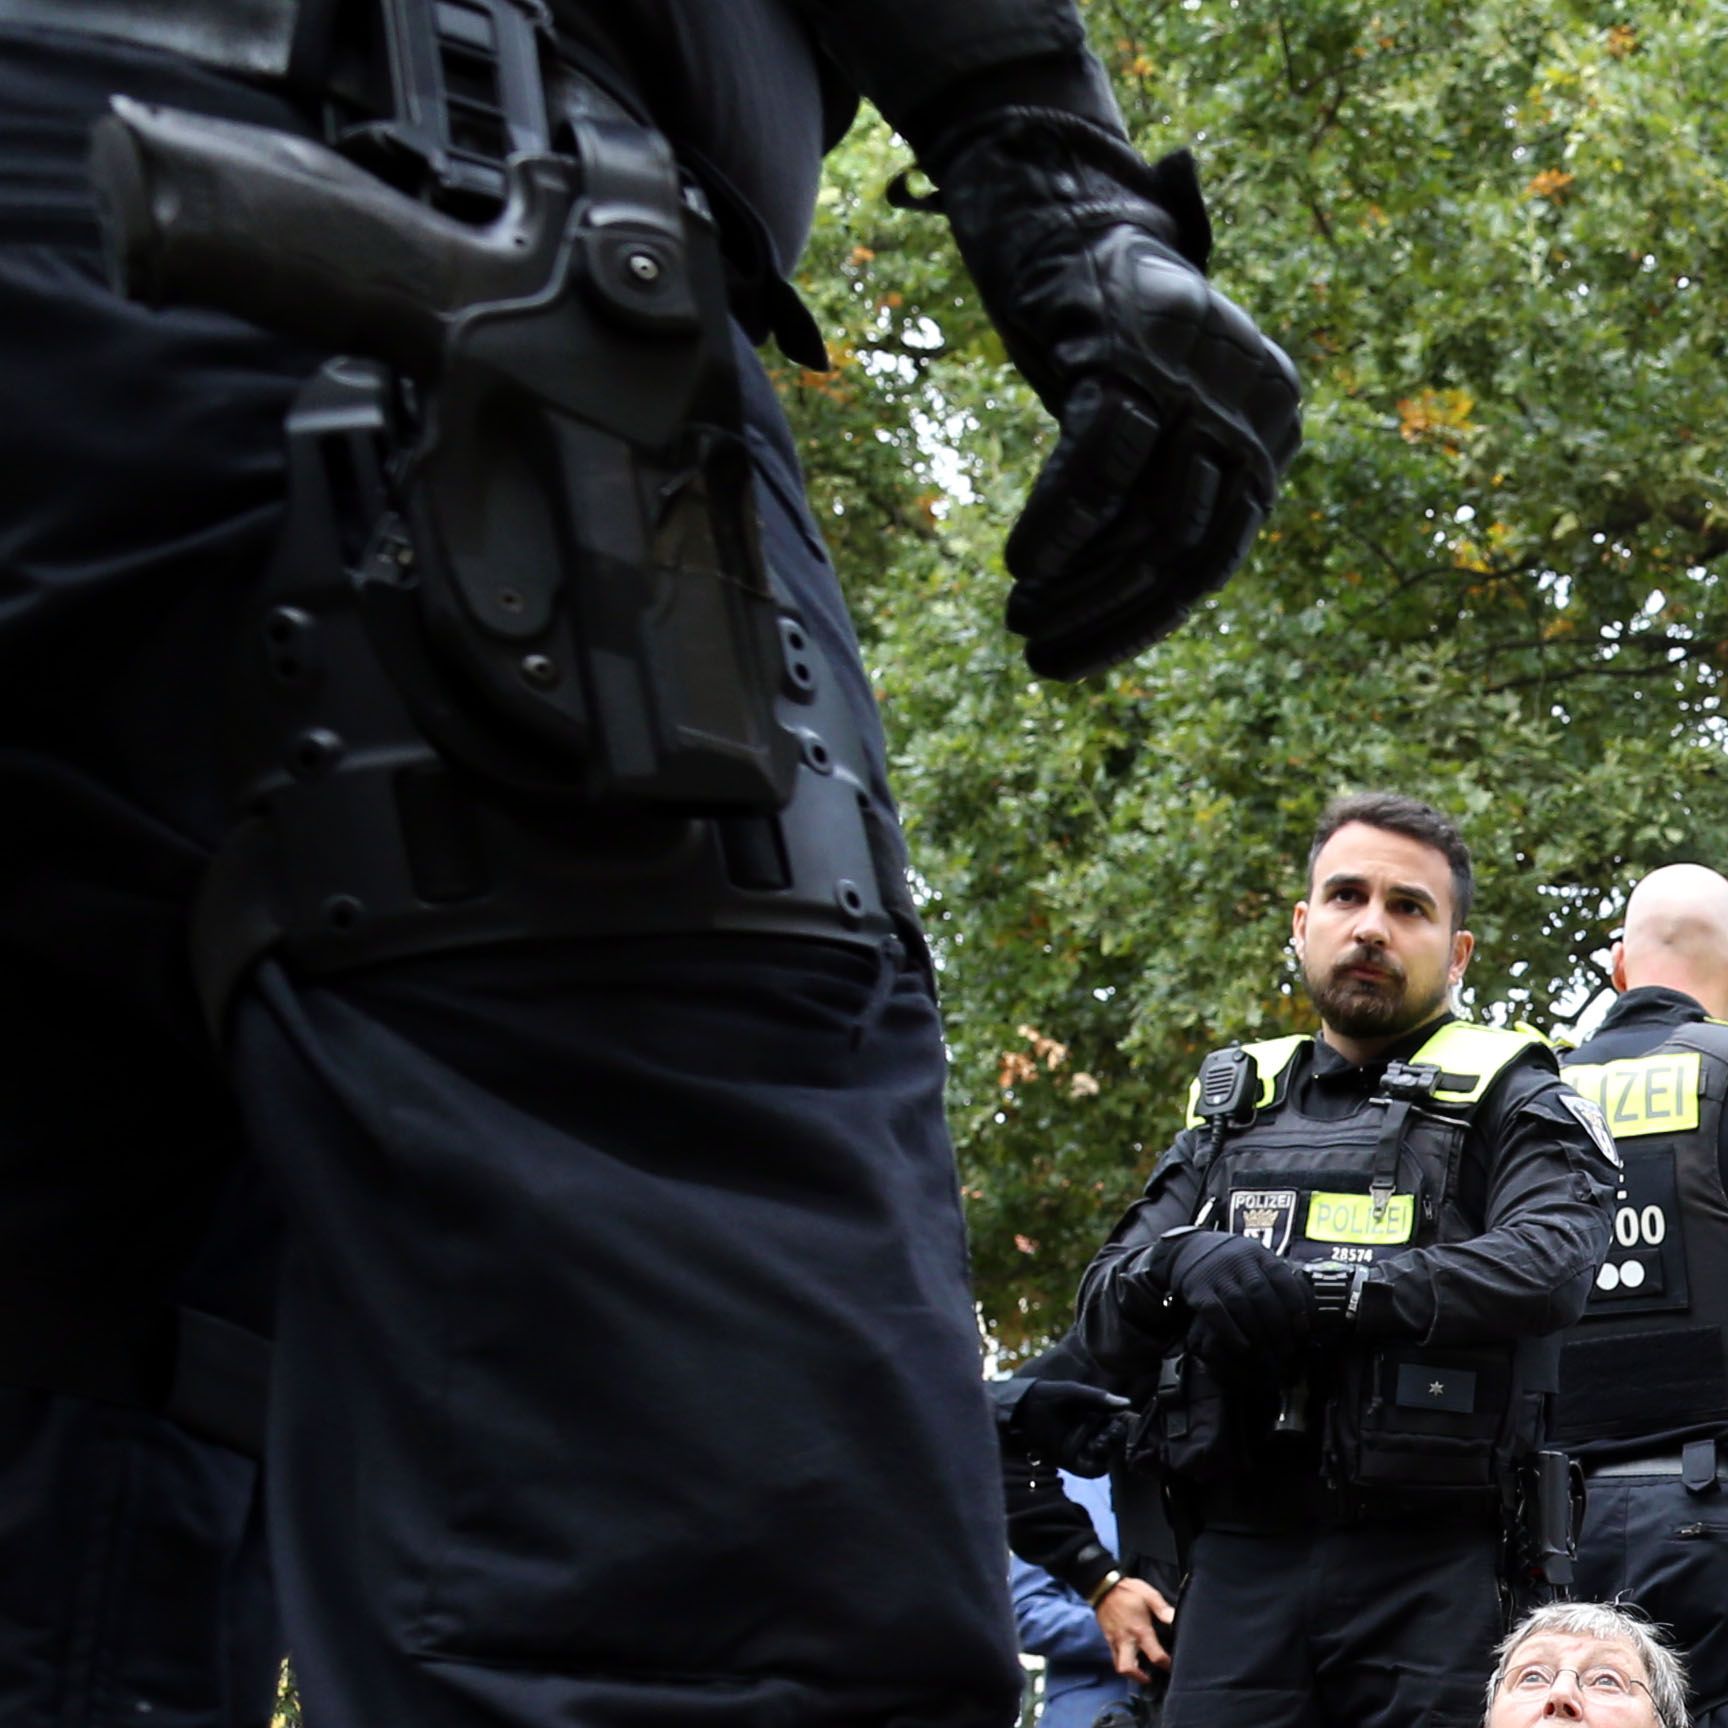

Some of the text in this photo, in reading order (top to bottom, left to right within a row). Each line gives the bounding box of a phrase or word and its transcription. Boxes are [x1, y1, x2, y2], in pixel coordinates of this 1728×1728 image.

[1573, 1065, 1684, 1124] IZEI
[1234, 1194, 1292, 1210] POLIZEI
[1610, 1204, 1666, 1248] 00
[1330, 1246, 1374, 1263] 28574
